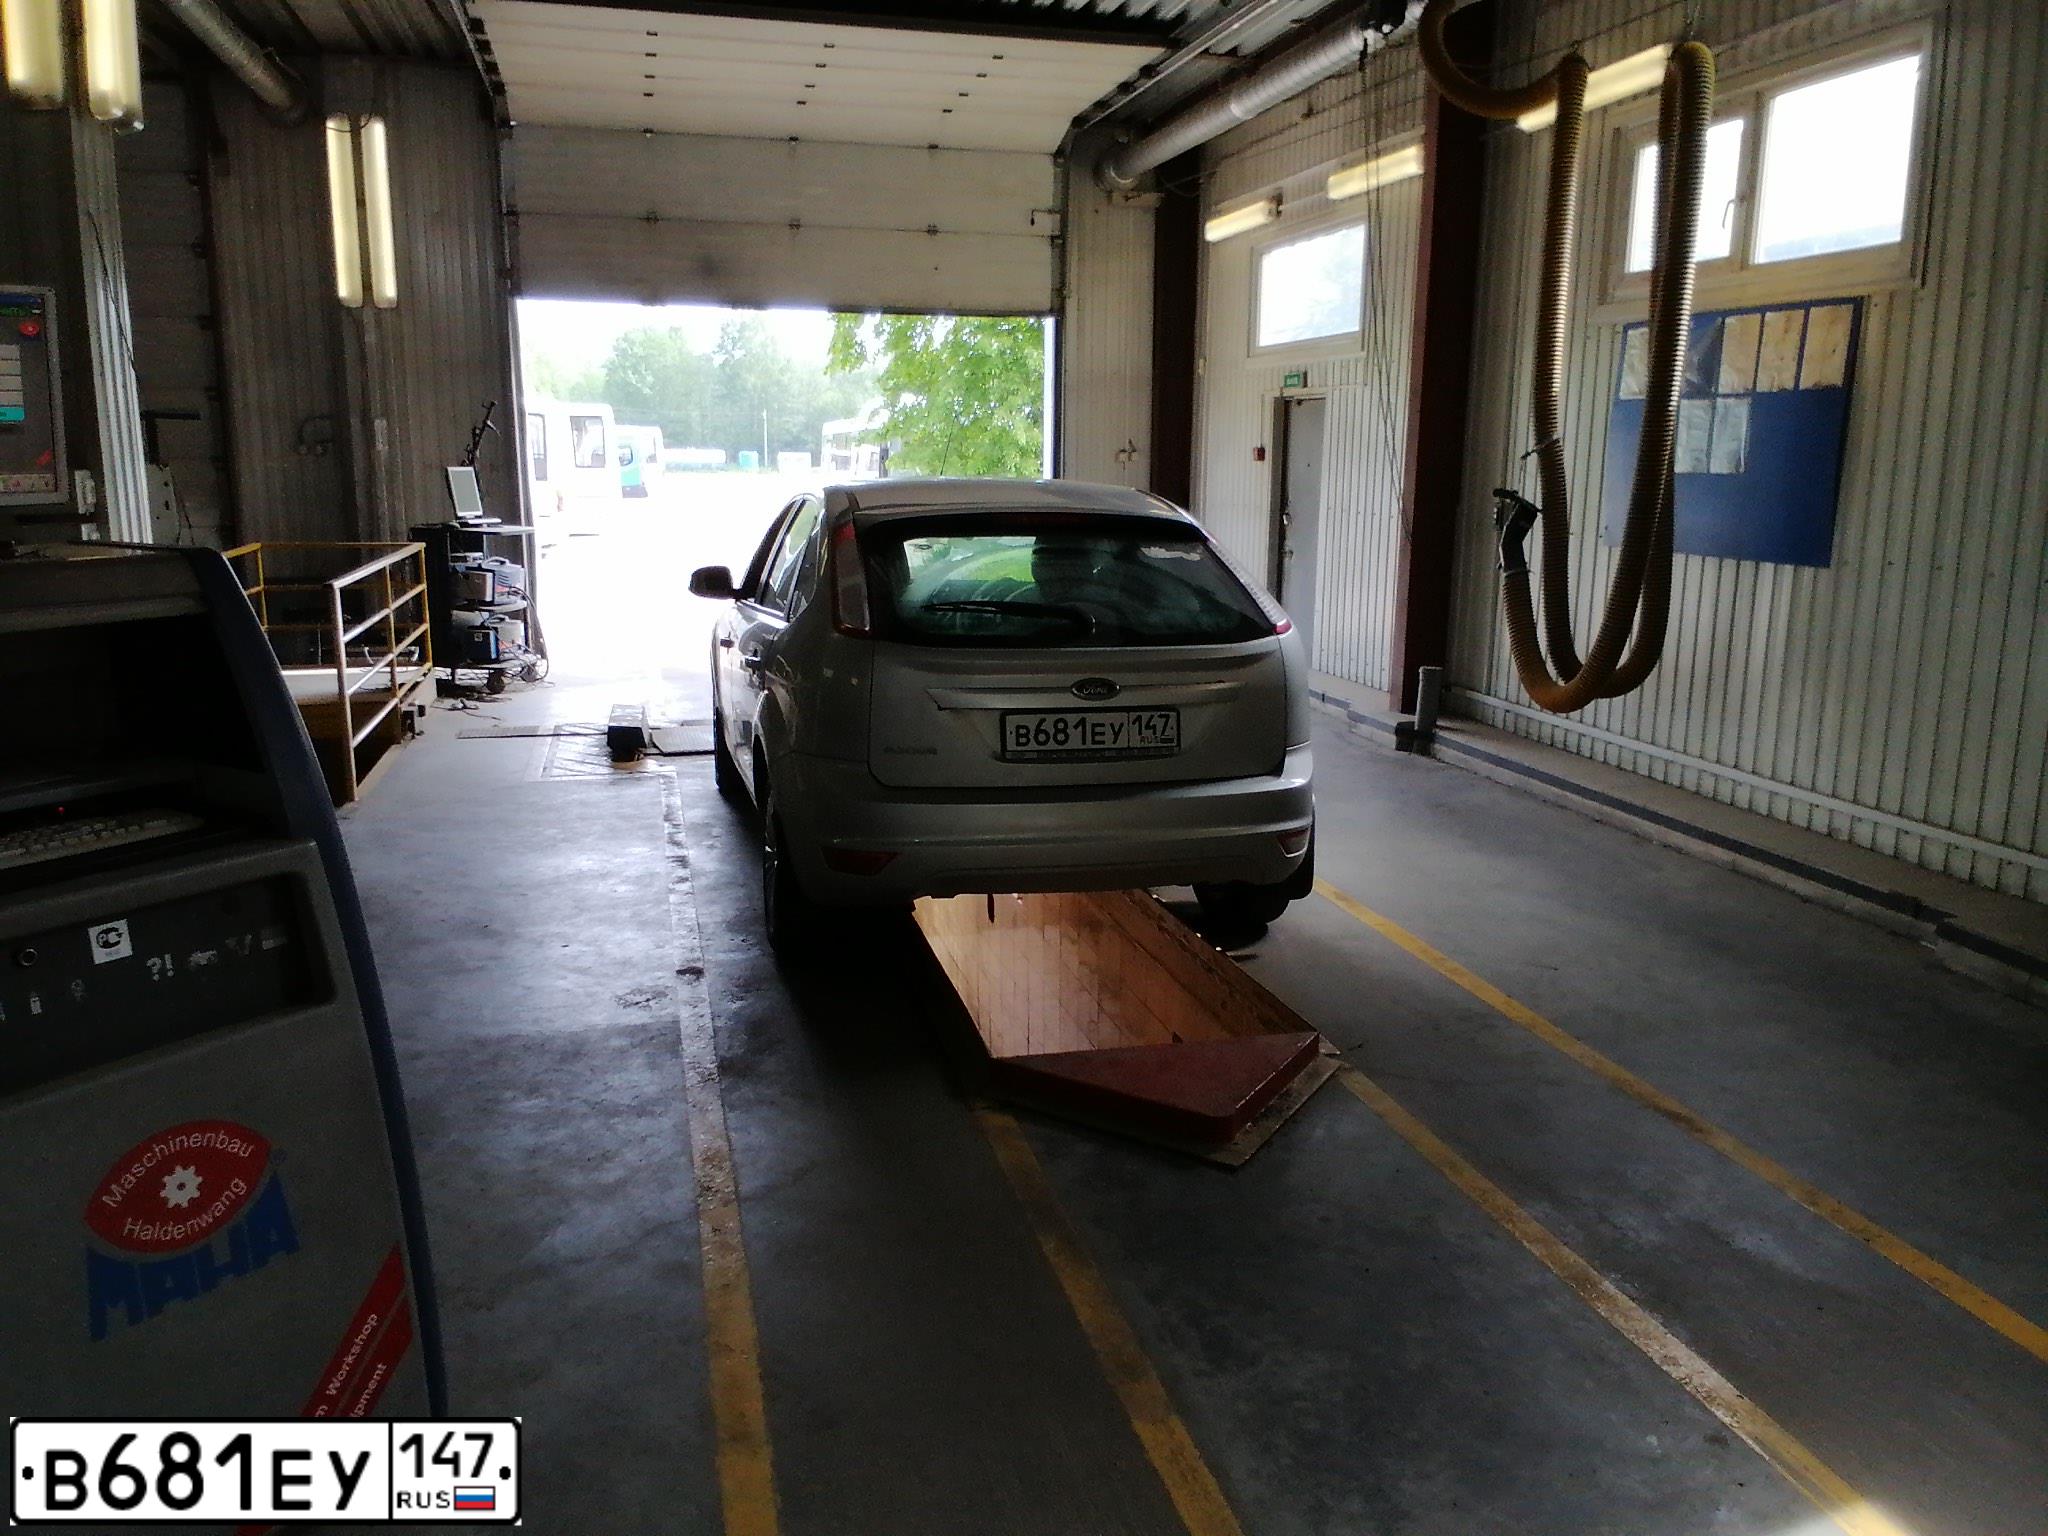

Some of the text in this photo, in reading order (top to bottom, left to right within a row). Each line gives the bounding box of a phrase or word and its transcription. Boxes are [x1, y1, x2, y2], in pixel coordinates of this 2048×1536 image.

[1132, 713, 1171, 737] 147
[102, 1130, 254, 1208] Maschinenbau
[123, 1176, 249, 1242] Haldenwang
[325, 1313, 378, 1396] Workshop
